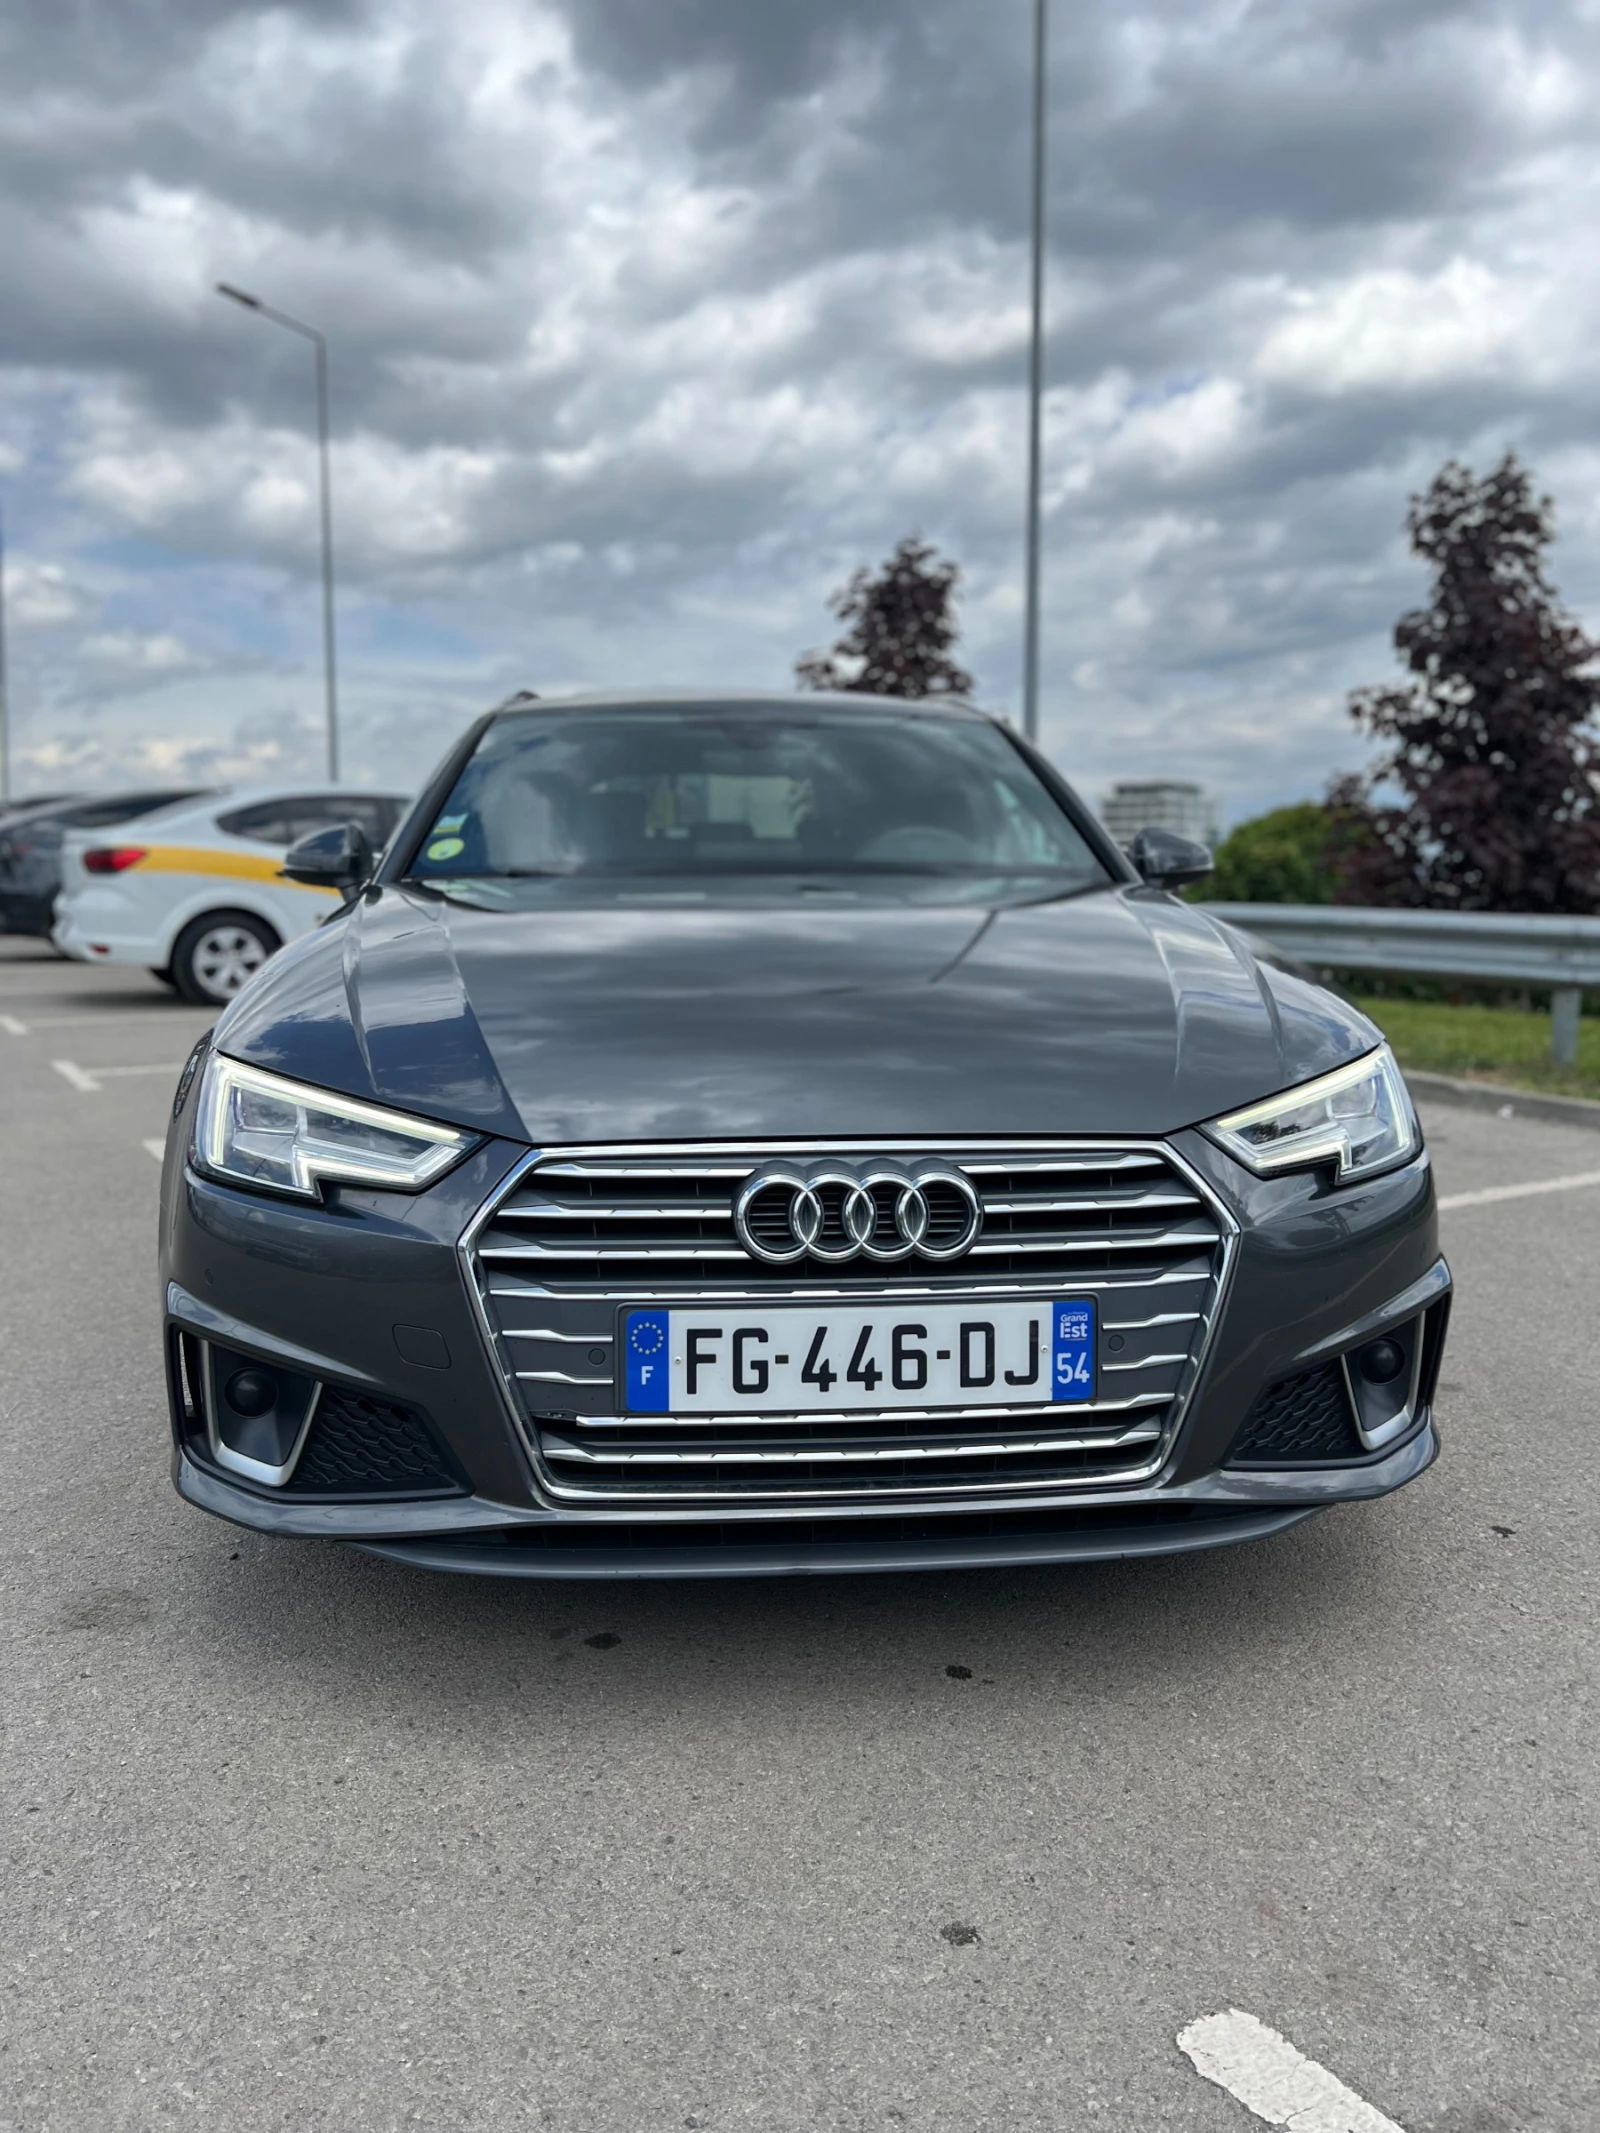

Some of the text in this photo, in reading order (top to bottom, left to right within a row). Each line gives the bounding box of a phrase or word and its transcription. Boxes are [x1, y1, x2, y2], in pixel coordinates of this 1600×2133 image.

[1060, 1313, 1088, 1322] Grand
[1060, 1322, 1088, 1339] Est
[685, 1319, 1040, 1395] FG-446-DJ
[1057, 1351, 1090, 1384] 54
[641, 1365, 654, 1386] F
